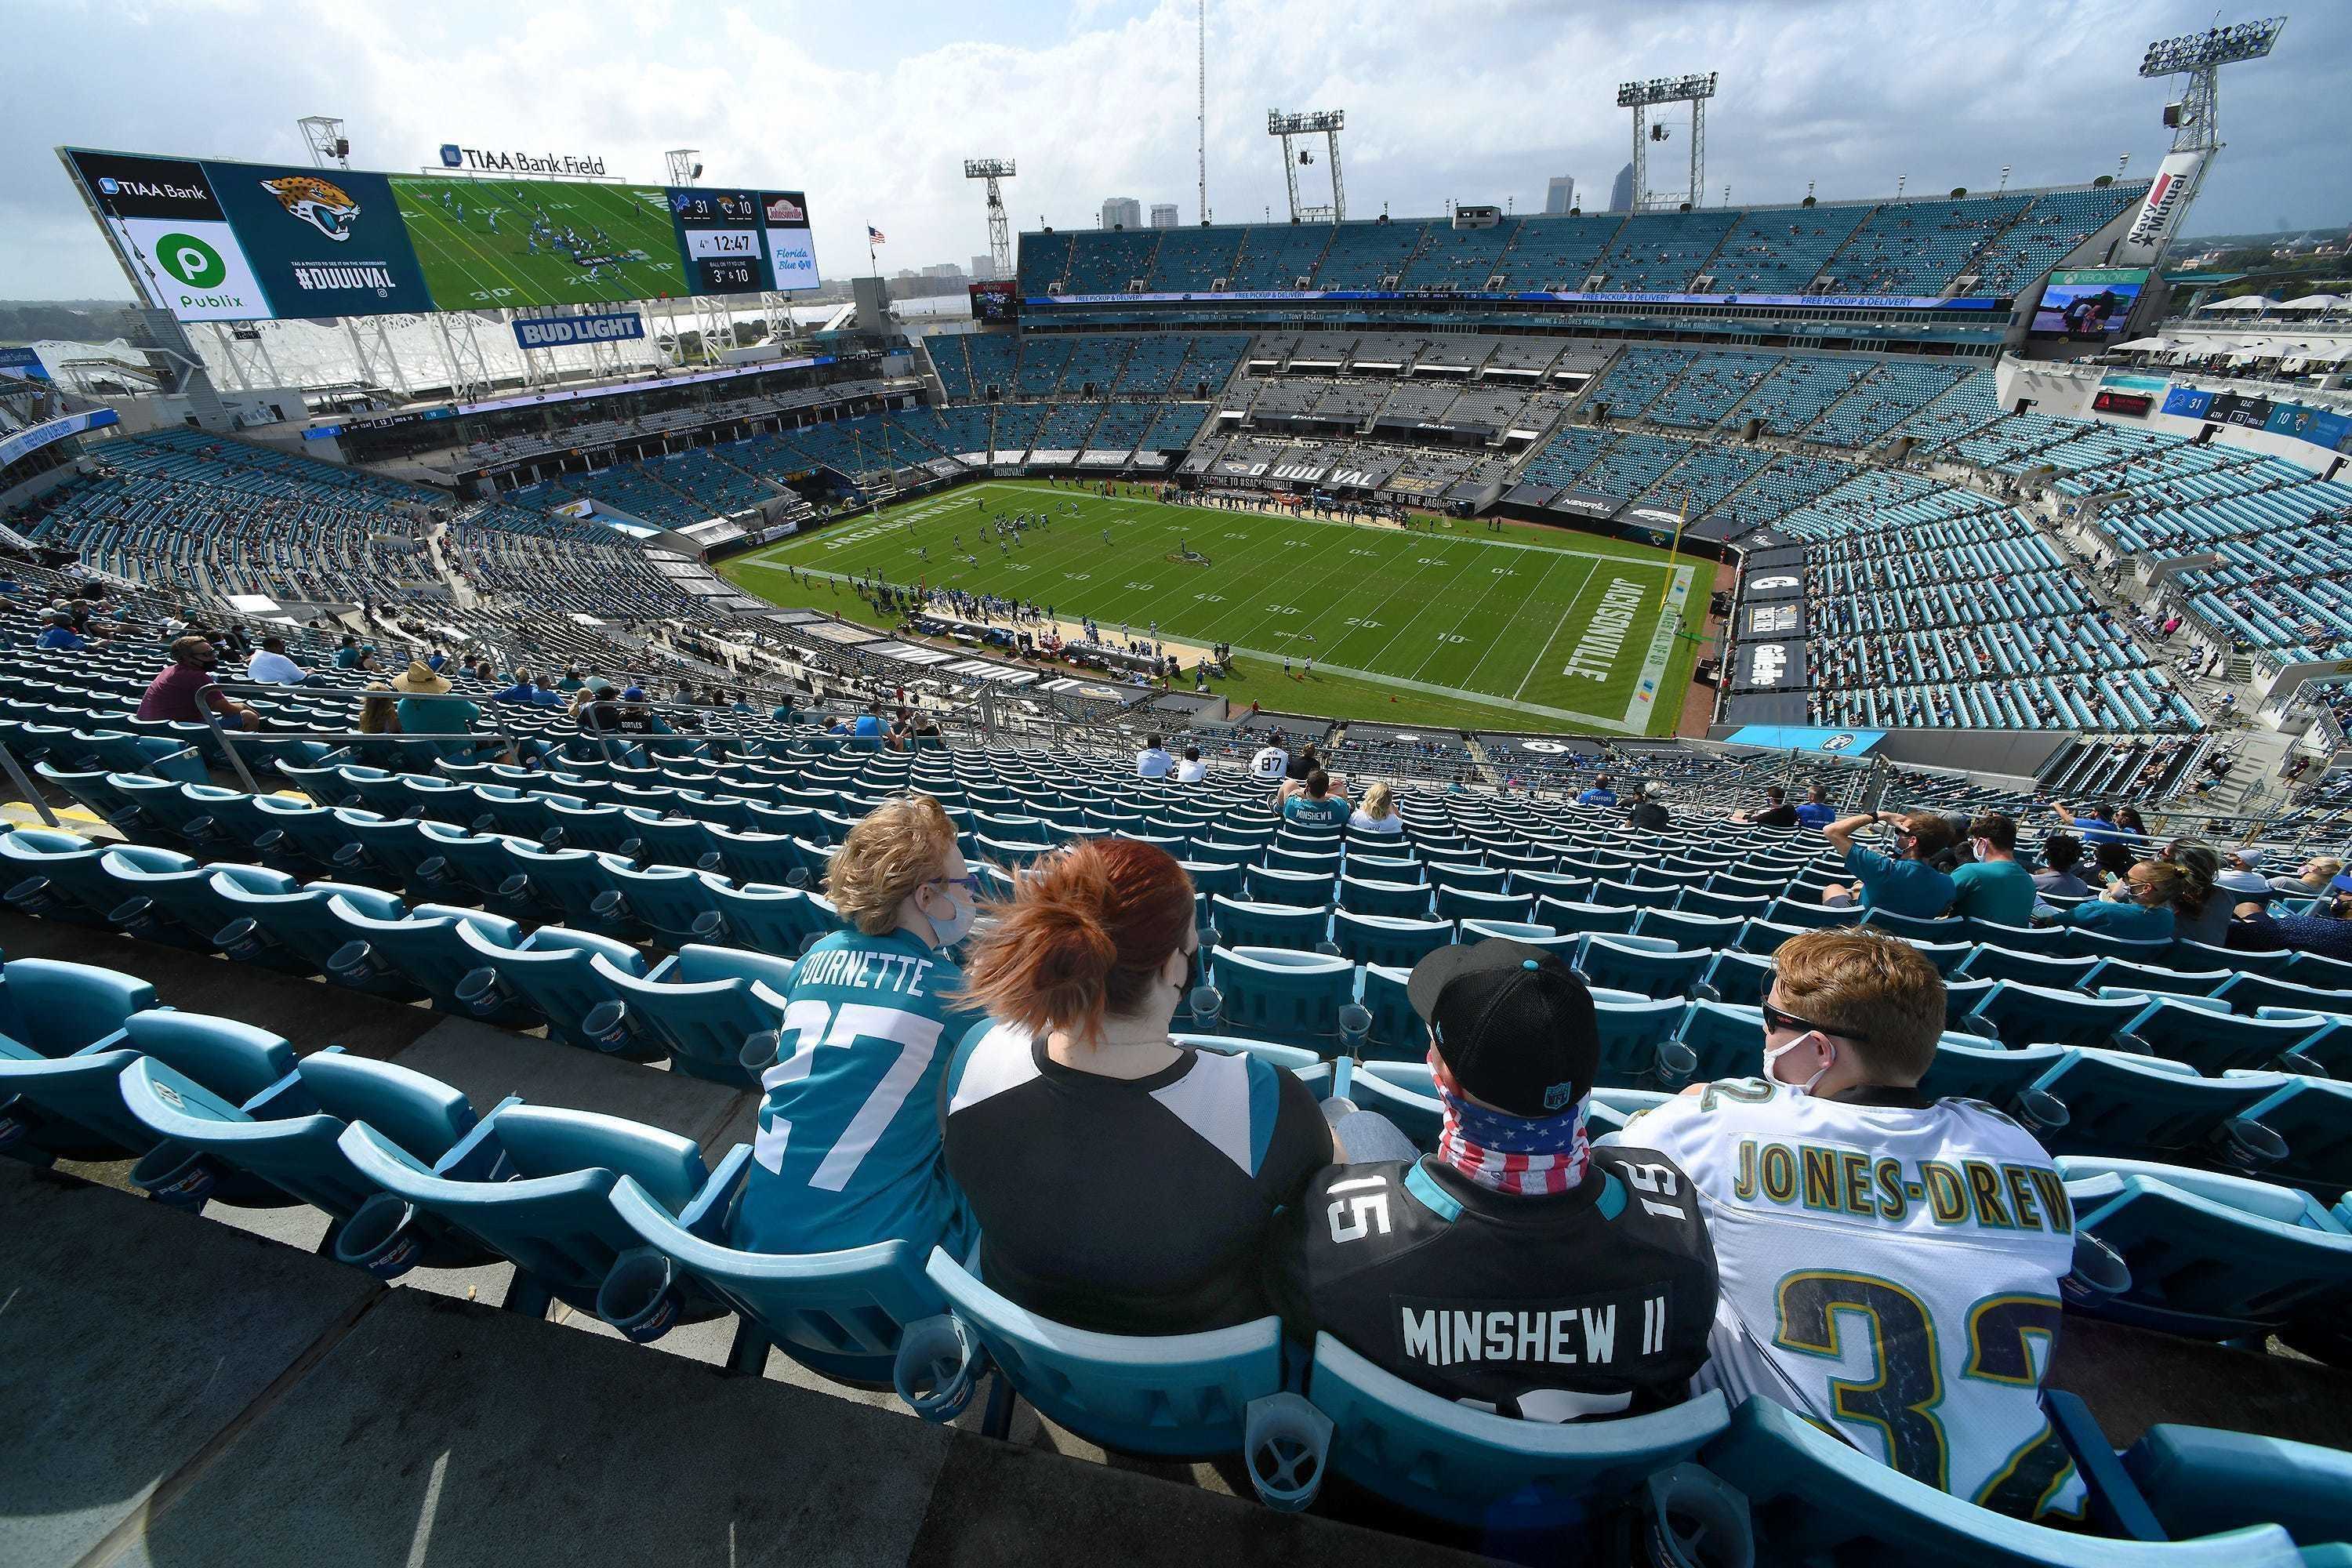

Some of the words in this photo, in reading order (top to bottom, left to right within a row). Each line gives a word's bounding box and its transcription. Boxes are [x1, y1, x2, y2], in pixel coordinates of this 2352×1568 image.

[463, 149, 515, 170] TIAA
[516, 152, 562, 173] Bank
[564, 155, 605, 176] Field
[118, 180, 165, 197] TIAA
[164, 184, 207, 200] Bank
[695, 199, 708, 214] 31
[739, 201, 752, 214] 10
[2147, 174, 2187, 231] Mutual
[769, 207, 803, 220] Johnsonville
[2129, 204, 2158, 244] Navy
[713, 235, 749, 251] 12:47
[776, 249, 808, 259] Florida
[778, 261, 797, 270] Blue
[295, 267, 396, 289] #DUUUVAL
[735, 269, 749, 282] 10
[2078, 274, 2108, 282] XBOX
[2108, 273, 2132, 281] ONE
[180, 295, 244, 307] Publix
[1867, 297, 1913, 307] DELIVERY
[522, 323, 573, 343] BUD
[574, 318, 635, 339] LIGHT
[2189, 398, 2202, 409] 31
[2240, 399, 2254, 408] 12:47
[2210, 411, 2223, 419] 4TH
[2277, 412, 2290, 425] 10
[670, 429, 685, 437] DREAM
[684, 426, 702, 435] FINDERS
[578, 446, 596, 456] DREAM
[597, 443, 616, 452] FINDERS
[486, 466, 503, 476] DREAM
[503, 461, 521, 471] FINDERS
[1196, 474, 1227, 486] WELCOME
[1229, 475, 1238, 486] TO
[1240, 476, 1293, 490] #SACKSONVILLE
[1374, 490, 1393, 503] HOME
[1397, 492, 1405, 503] OF
[1408, 494, 1420, 506] THE
[1563, 499, 1610, 512] NEXGRILL
[824, 495, 976, 550] JACKSONVILLE
[1124, 582, 1154, 590] 50
[1563, 578, 1646, 682] JACKSONVILLE
[1651, 644, 1668, 654] OF
[1649, 655, 1664, 666] US
[1751, 644, 1786, 686] Gillette
[1262, 757, 1282, 772] 87
[1296, 809, 1326, 821] MINSHEW
[1327, 811, 1332, 821] II
[800, 947, 934, 997] FOURNETTE
[473, 991, 495, 1005] PEPSI
[601, 1027, 622, 1042] PEPSI
[753, 1000, 945, 1192] 27
[158, 1168, 202, 1194] PEPSI
[1734, 1139, 2073, 1236] JONES-DREW
[1615, 1160, 1686, 1221] 15
[1327, 1175, 1392, 1244] 15
[369, 1238, 410, 1269] PEPSI
[632, 1299, 670, 1332] PEPSI
[1402, 1305, 1617, 1367] MINSHEW
[1642, 1297, 1665, 1356] II
